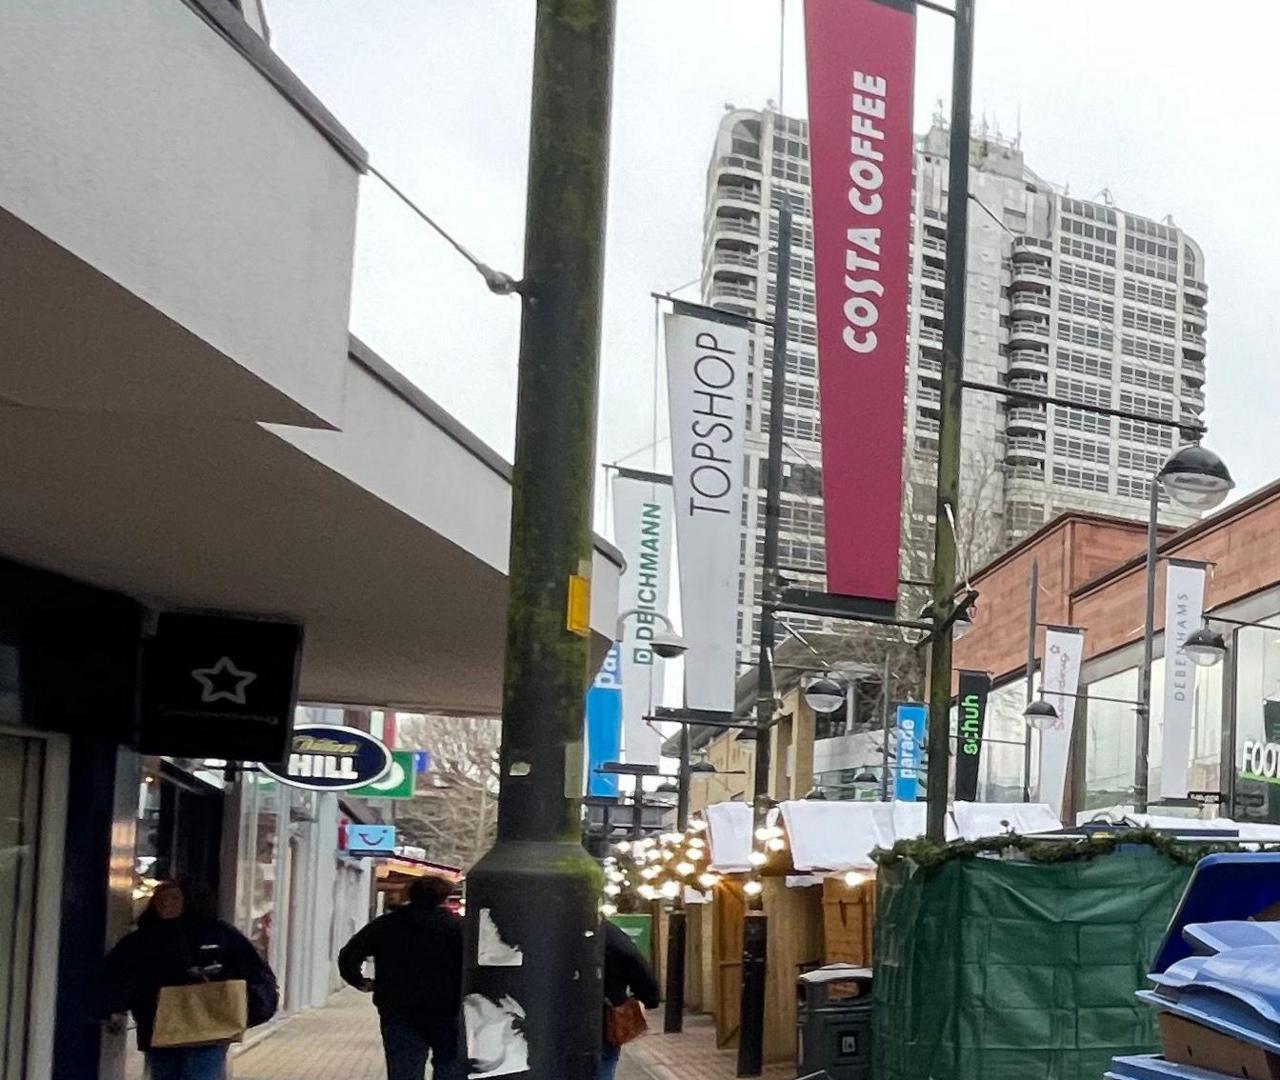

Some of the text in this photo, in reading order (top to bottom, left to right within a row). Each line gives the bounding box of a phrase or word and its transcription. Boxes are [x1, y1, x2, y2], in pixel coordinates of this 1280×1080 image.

[842, 70, 887, 354] COSTA COFFEE
[689, 332, 736, 517] TOPSHOP
[636, 502, 662, 642] DEICHMANN
[1174, 592, 1189, 702] DEBENHAMS
[286, 752, 359, 780] HILL
[899, 718, 917, 779] parade
[960, 693, 979, 756] schuh
